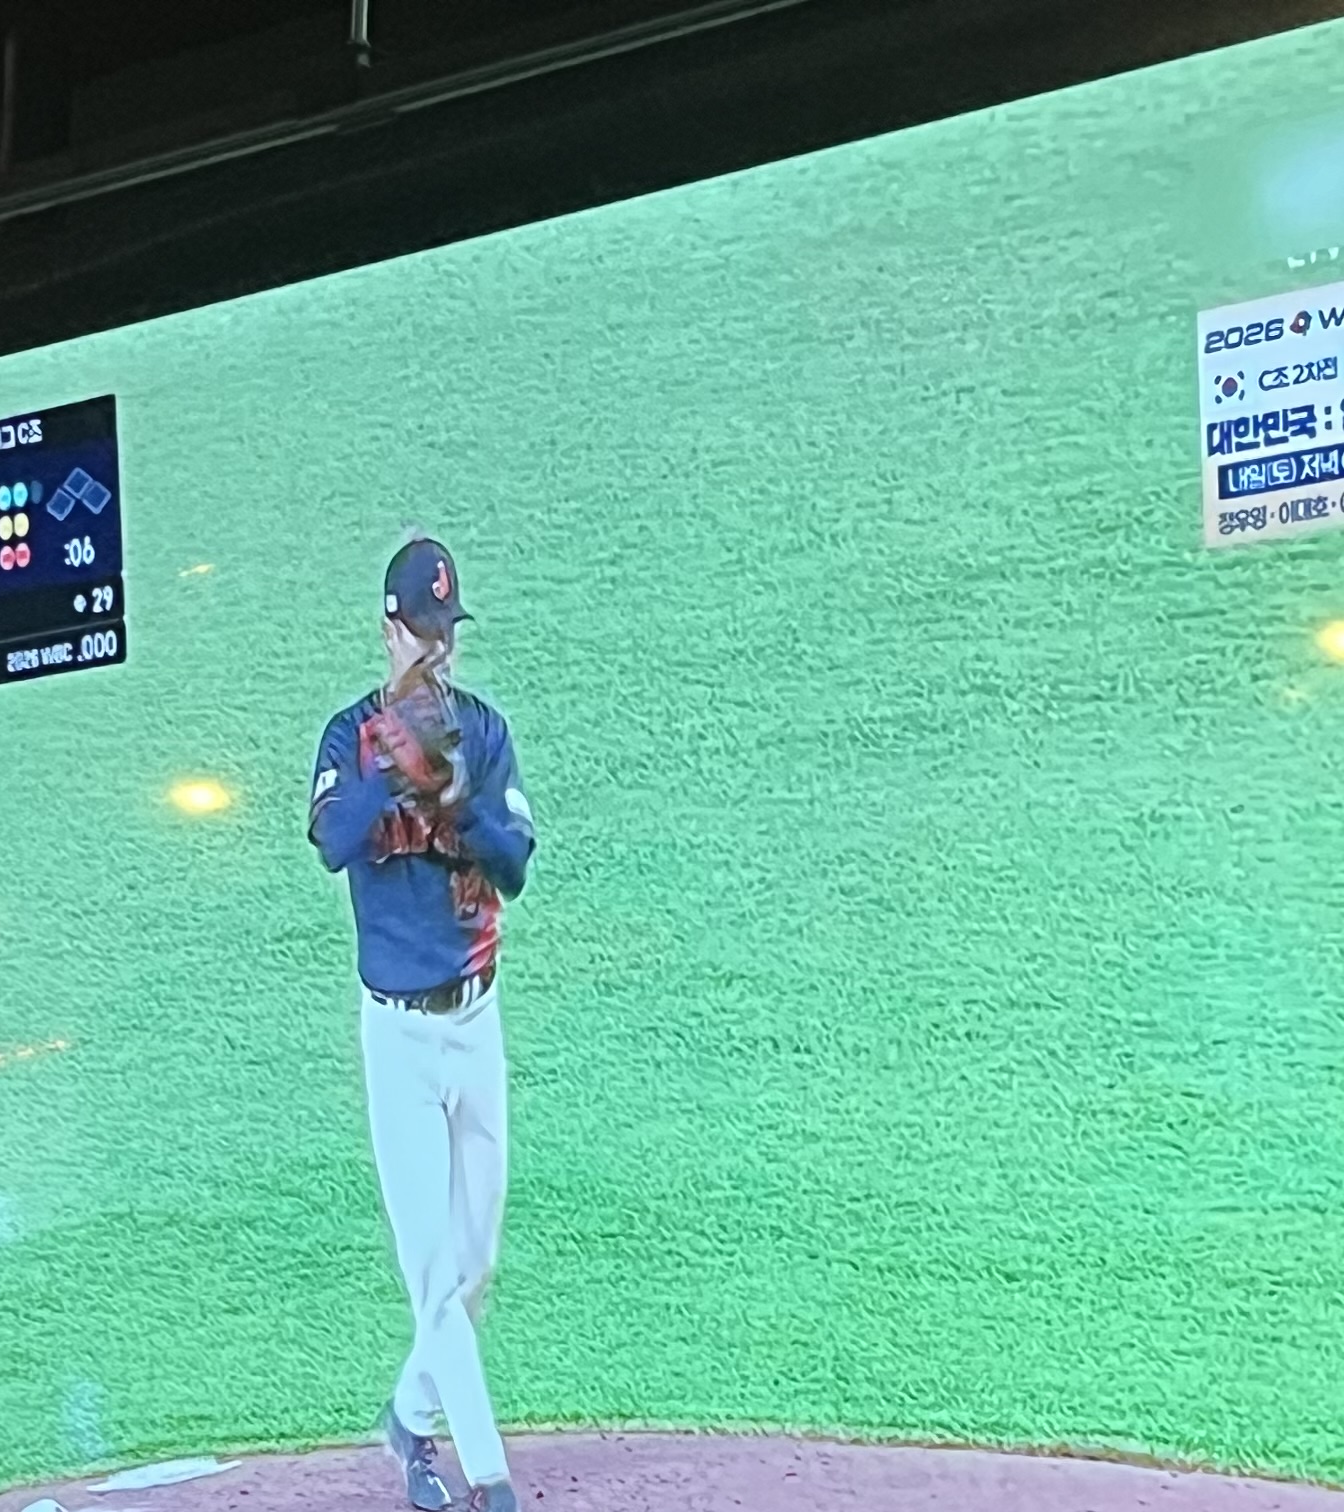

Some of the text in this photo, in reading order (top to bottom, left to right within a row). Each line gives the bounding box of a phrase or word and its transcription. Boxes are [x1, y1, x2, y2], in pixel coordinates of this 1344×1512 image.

[1204, 318, 1284, 354] 2026
[1206, 404, 1317, 457] 대한민국
[92, 585, 113, 613] 29
[77, 630, 117, 661] .000
